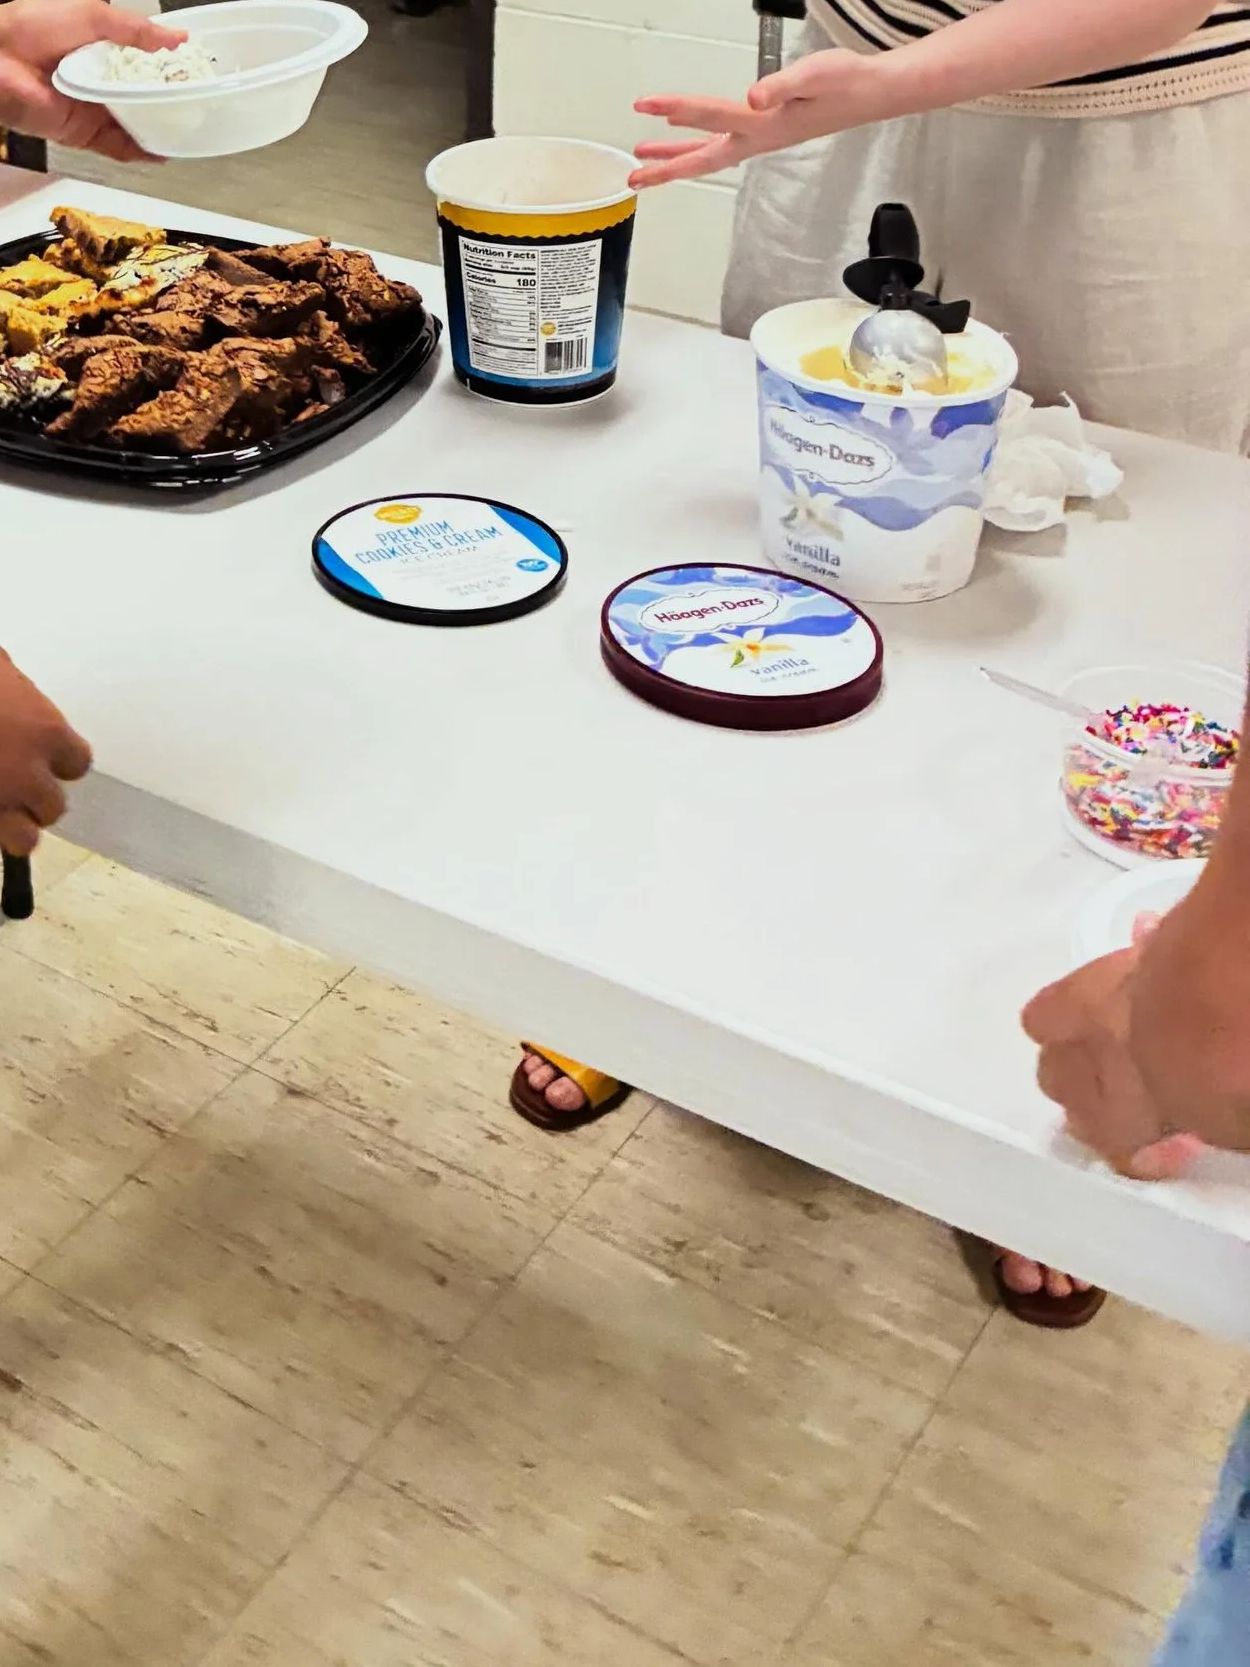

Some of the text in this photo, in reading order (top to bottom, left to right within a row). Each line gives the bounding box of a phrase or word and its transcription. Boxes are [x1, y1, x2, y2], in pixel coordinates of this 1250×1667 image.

[463, 243, 536, 259] Nutrition Facts
[466, 271, 536, 287] Calories 180
[376, 520, 454, 547] PREMIUM
[355, 540, 429, 565] COOKIES
[444, 526, 503, 548] CREAM
